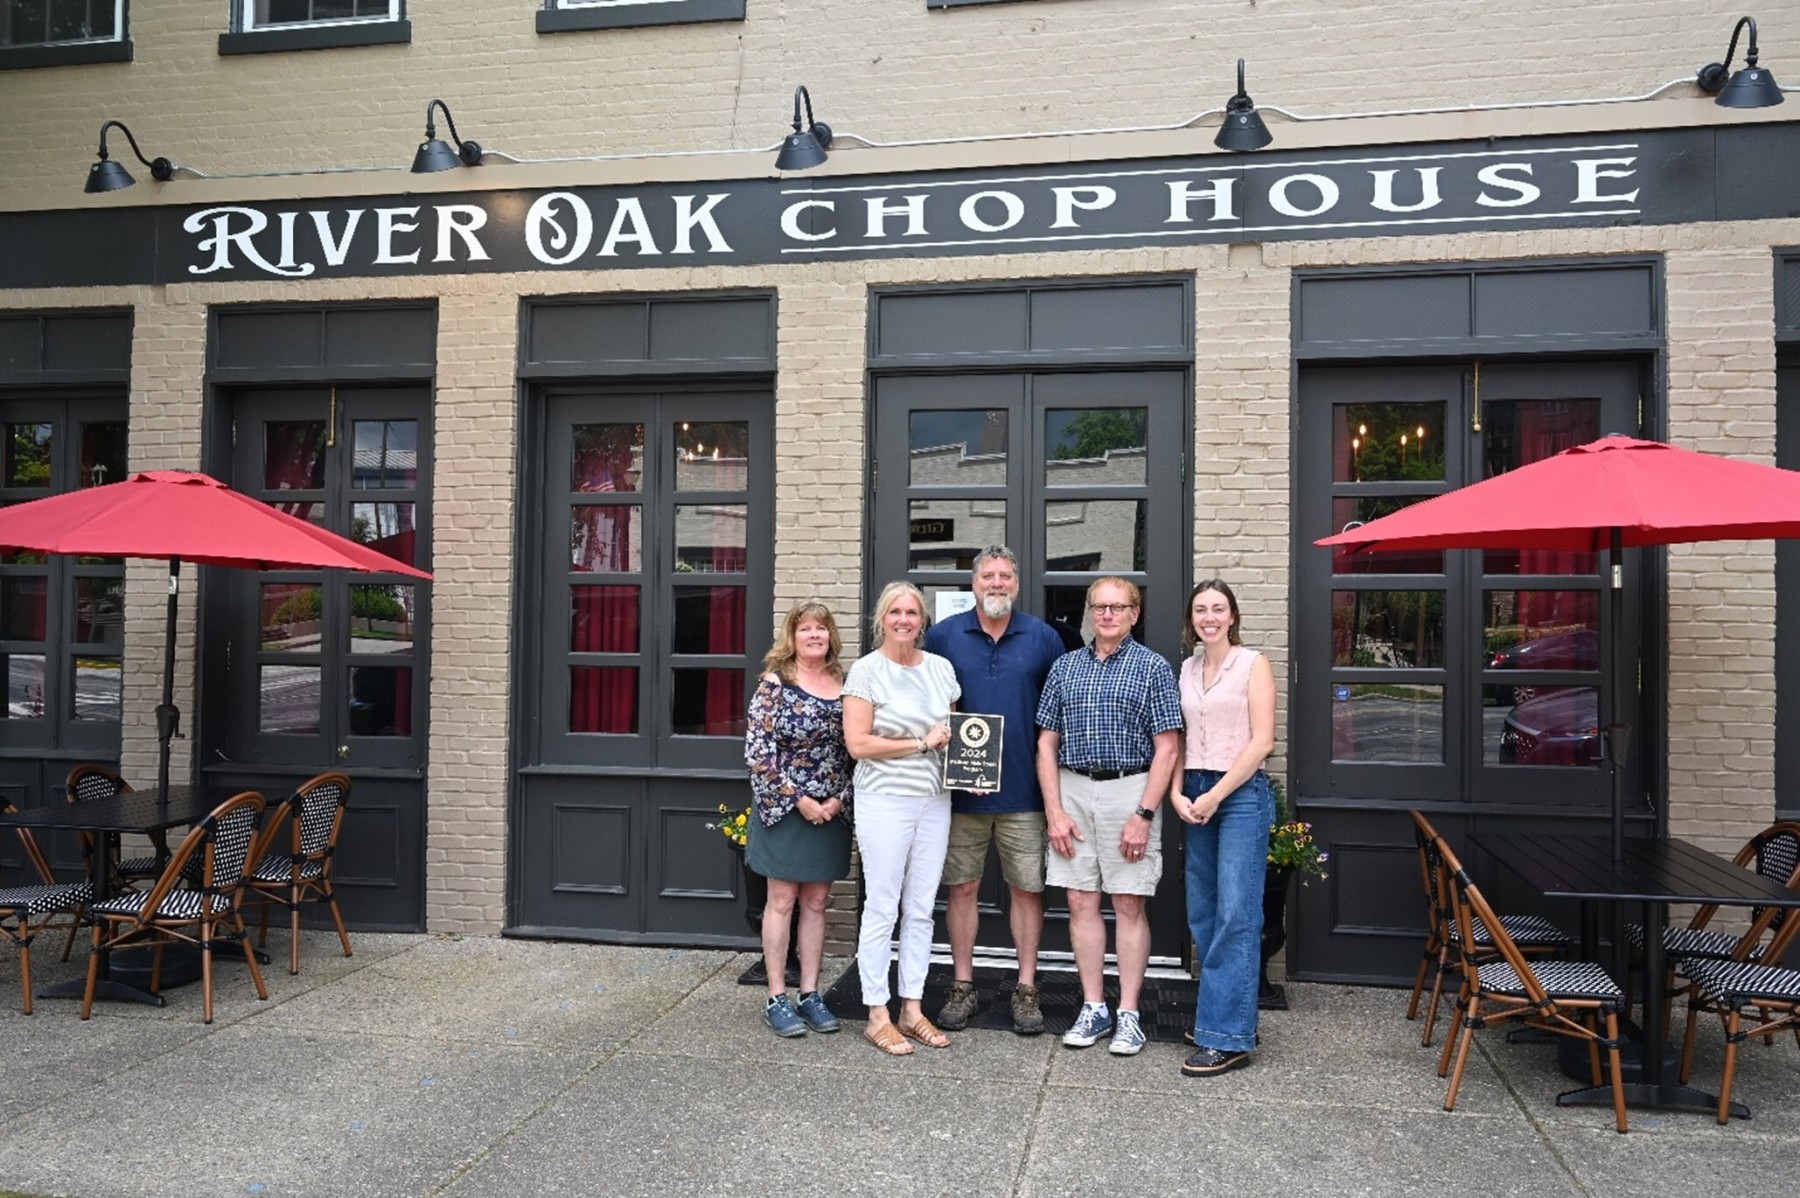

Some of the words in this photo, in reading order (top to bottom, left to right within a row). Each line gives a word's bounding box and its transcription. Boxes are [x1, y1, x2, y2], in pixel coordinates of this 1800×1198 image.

[184, 204, 492, 276] RIVER
[525, 193, 734, 265] OAK
[780, 186, 1117, 241] CHOP
[1165, 156, 1640, 223] HOUSE
[960, 748, 987, 758] 2024
